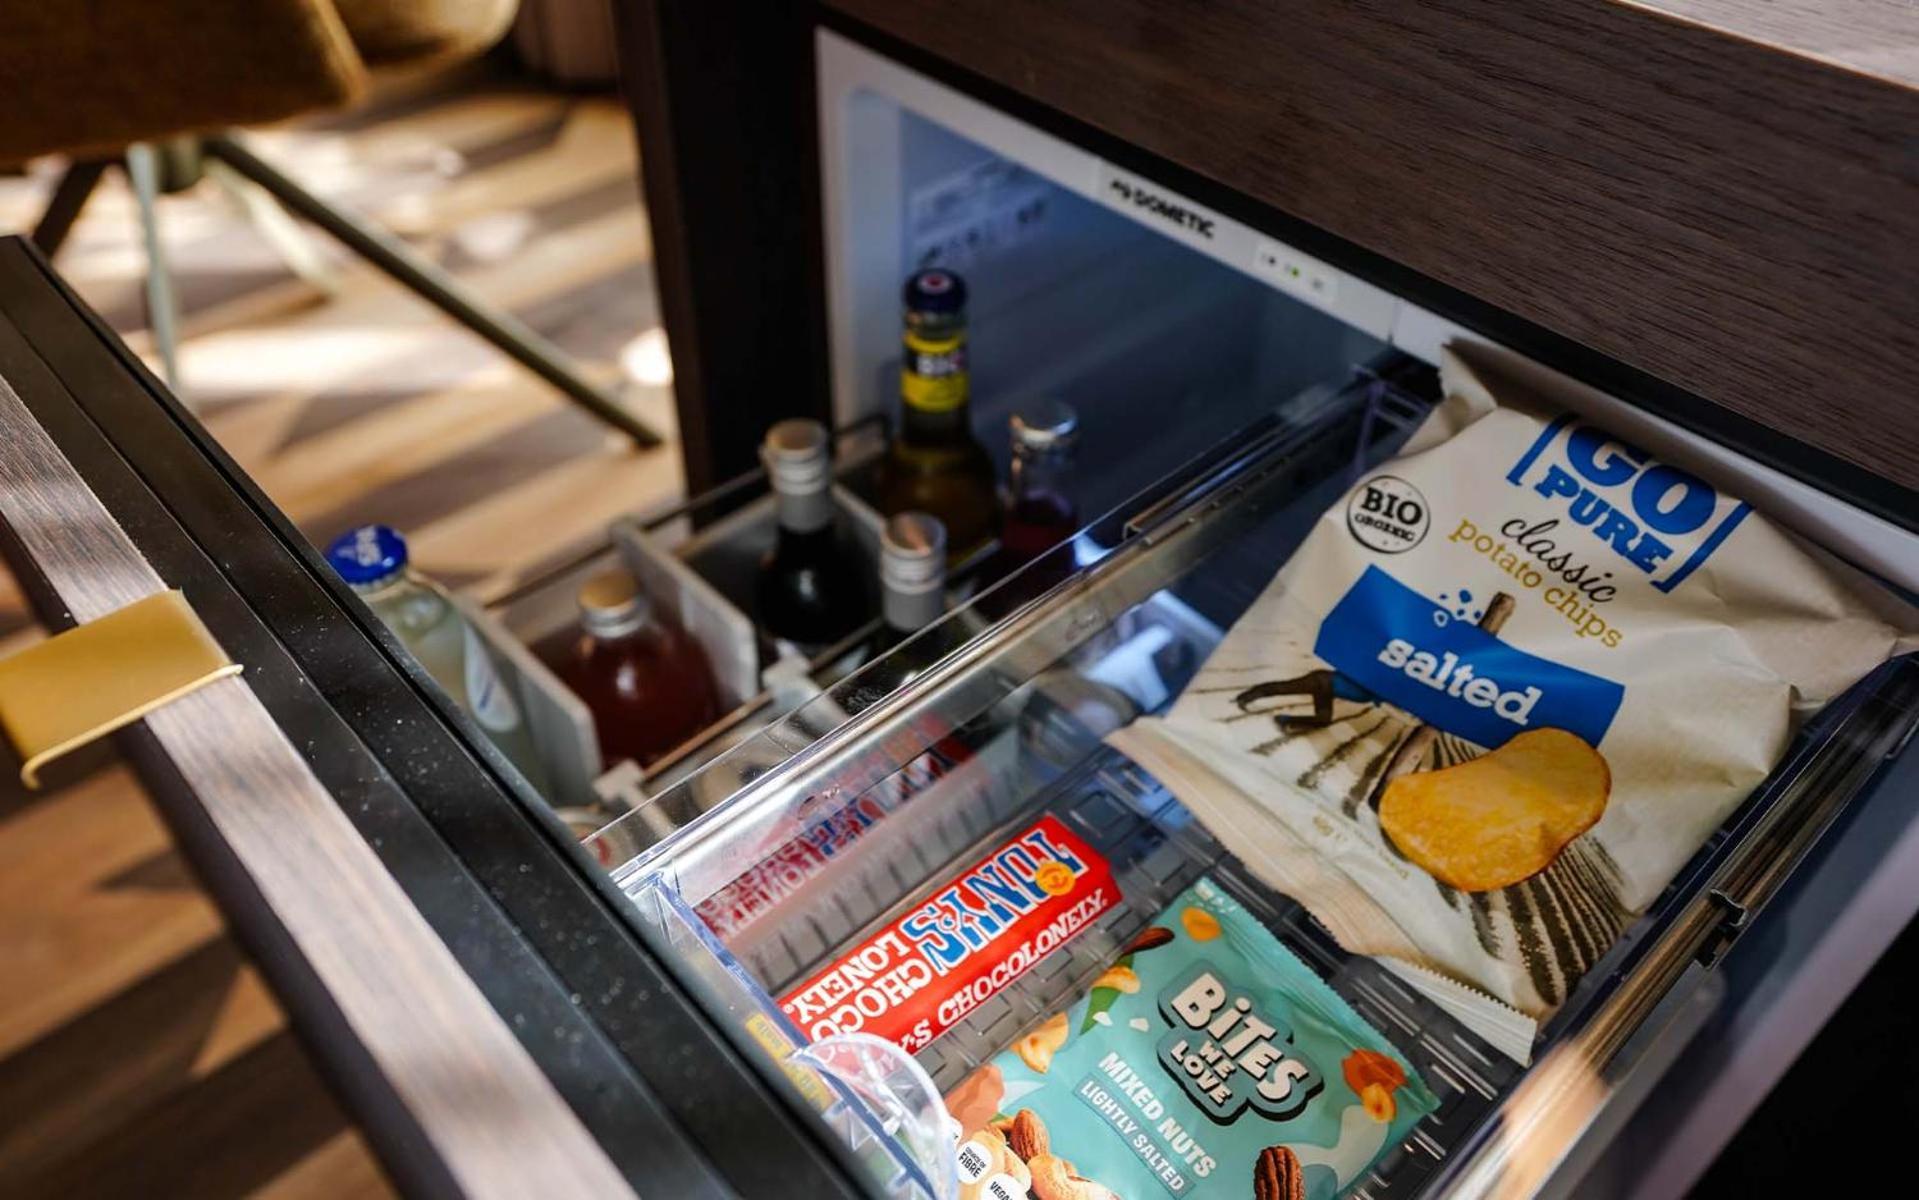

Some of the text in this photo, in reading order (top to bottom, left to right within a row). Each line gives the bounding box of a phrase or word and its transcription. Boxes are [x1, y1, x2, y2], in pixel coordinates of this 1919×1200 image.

[1361, 486, 1423, 525] BIO
[1534, 463, 1674, 574] PURE
[1567, 426, 1717, 535] GO
[1448, 519, 1623, 648] potato chips
[1501, 518, 1617, 603] classic
[1377, 638, 1543, 726] salted
[1170, 1039, 1233, 1106] LOVE
[1199, 1040, 1237, 1081] WE
[1080, 1080, 1185, 1191] LIGHTLY SALTED
[1098, 1051, 1217, 1178] MIXED NUTS
[958, 1151, 982, 1178] FIBRE
[989, 1181, 1015, 1200] VEGA
